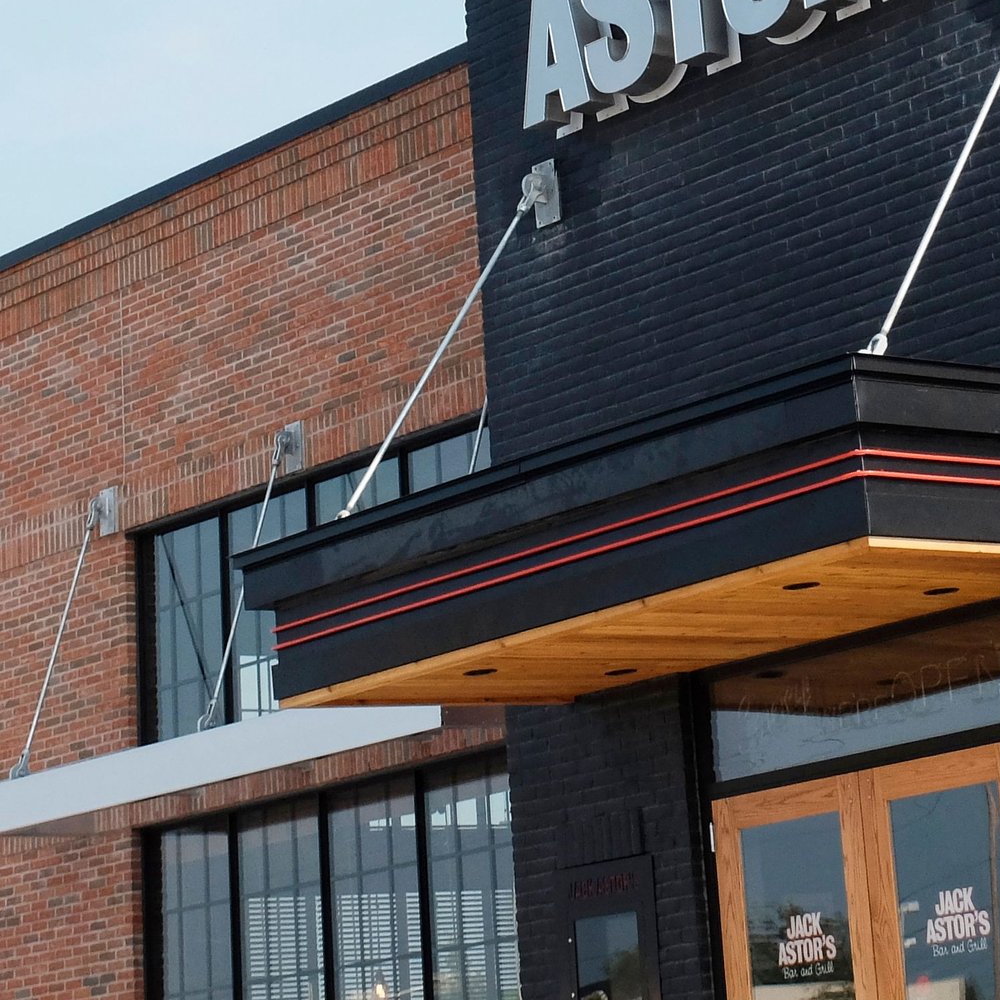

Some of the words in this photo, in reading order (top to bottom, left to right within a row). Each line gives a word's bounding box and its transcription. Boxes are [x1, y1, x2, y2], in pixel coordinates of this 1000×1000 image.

[934, 886, 976, 916] JACK
[786, 911, 823, 940] JACK
[926, 910, 991, 944] ASTOR'S
[778, 934, 837, 966] ASTOR'S
[932, 943, 949, 957] Bar
[951, 941, 965, 954] and
[967, 937, 988, 953] Grill
[782, 966, 798, 980] Bar
[800, 964, 813, 977] and
[815, 960, 834, 976] Grill
